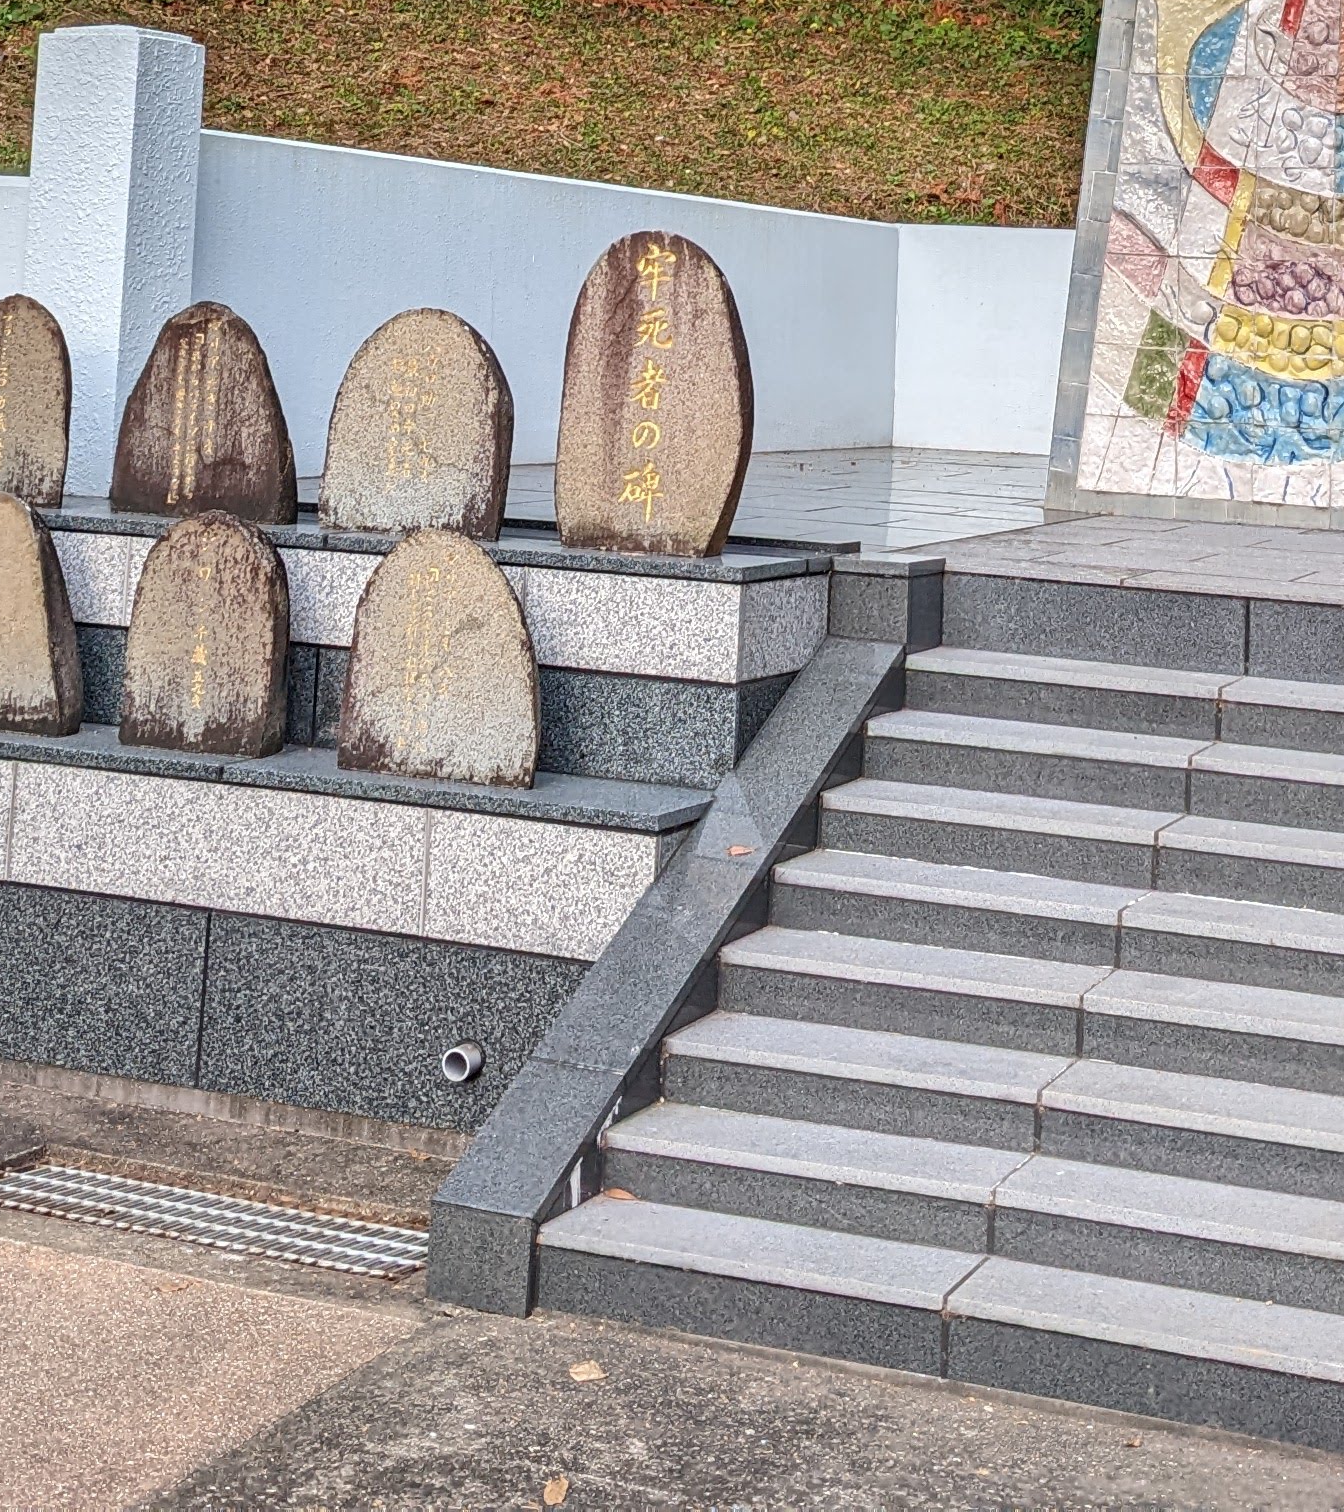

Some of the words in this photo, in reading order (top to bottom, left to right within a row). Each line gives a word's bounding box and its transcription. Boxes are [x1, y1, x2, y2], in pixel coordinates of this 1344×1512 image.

[617, 243, 677, 524] 牢死者の碑
